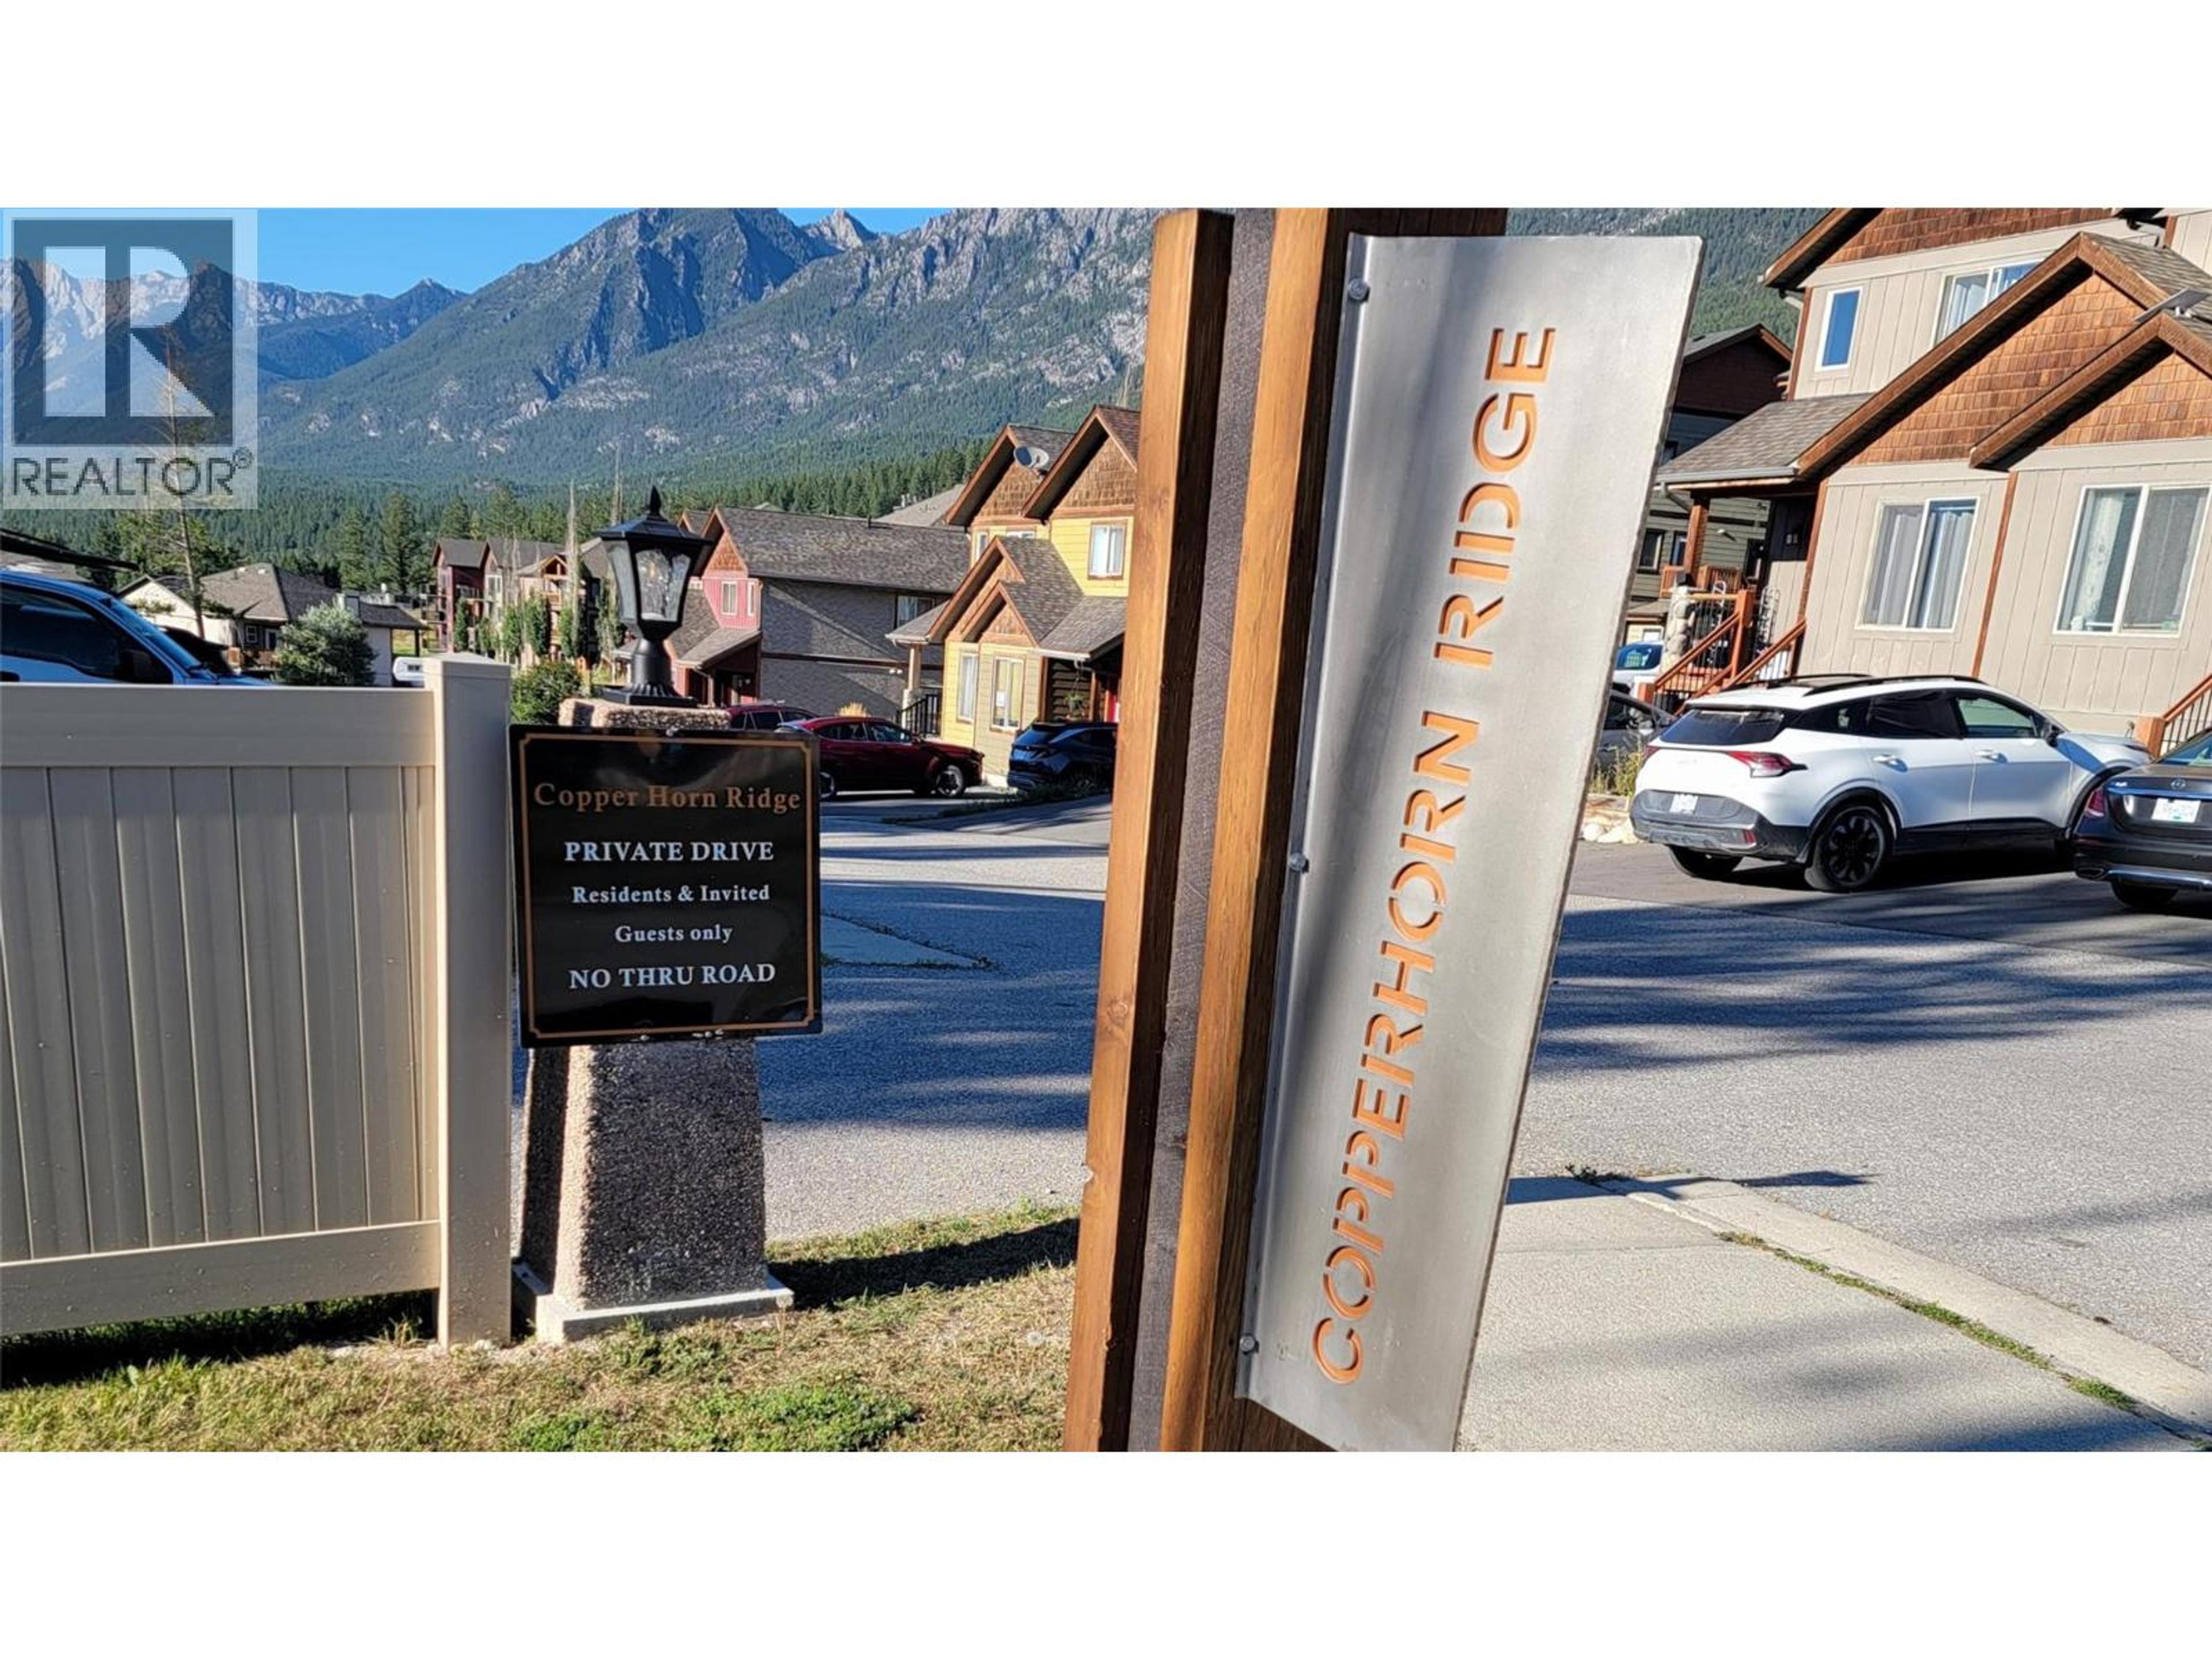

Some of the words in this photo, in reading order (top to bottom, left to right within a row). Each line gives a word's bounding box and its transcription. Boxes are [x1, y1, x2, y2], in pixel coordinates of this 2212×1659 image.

[534, 783, 639, 812] Copper
[648, 785, 717, 808] Horn
[726, 787, 801, 813] Ridge
[564, 842, 684, 862] PRIVATE
[691, 842, 775, 861] DRIVE
[1312, 710, 1480, 1384] COPPERHORN
[1433, 327, 1556, 668] RIDGE
[572, 887, 672, 904] Residents
[678, 885, 695, 902] &
[700, 885, 771, 902] Invited
[615, 926, 684, 942] Guests
[690, 924, 733, 944] only
[568, 968, 612, 990] NO
[618, 966, 695, 987] THRU
[700, 963, 777, 984] ROAD
